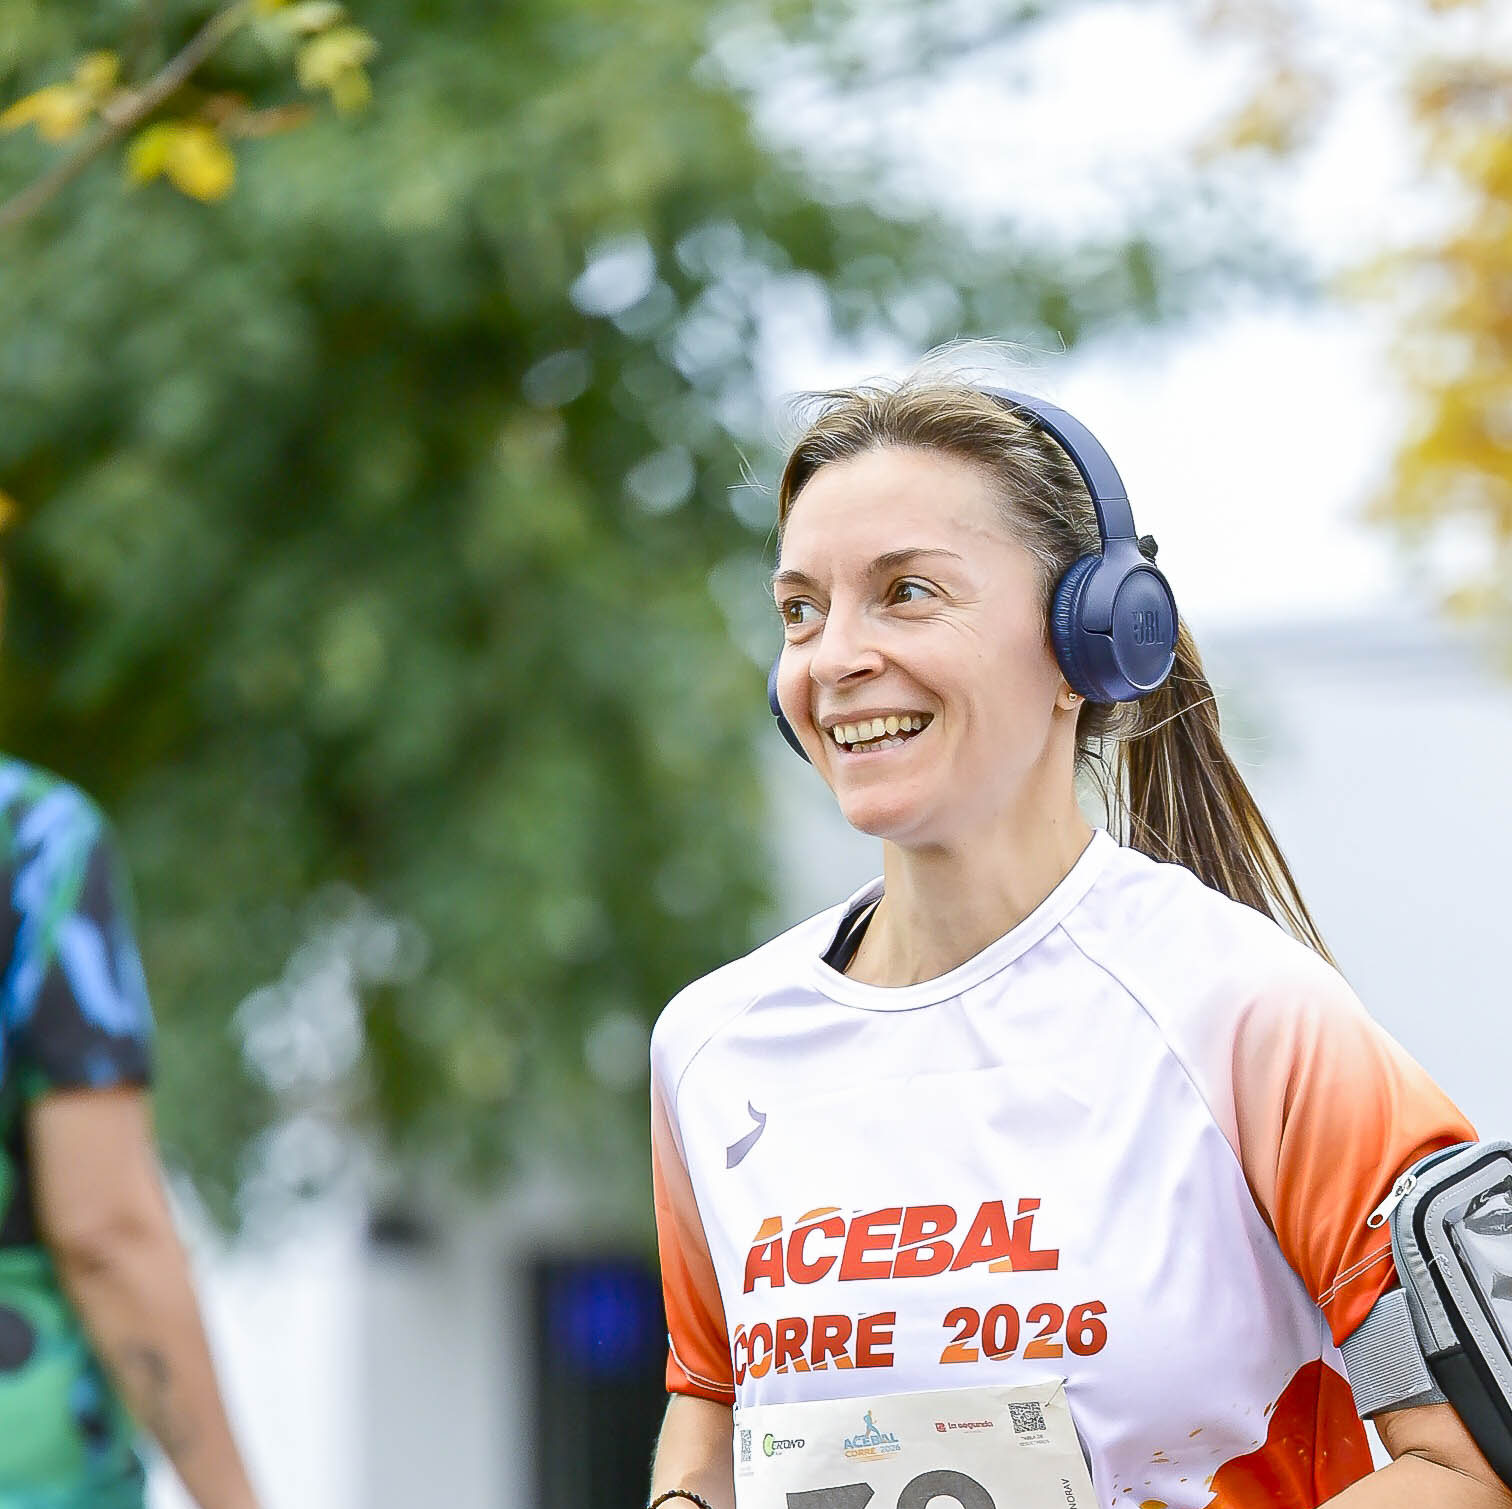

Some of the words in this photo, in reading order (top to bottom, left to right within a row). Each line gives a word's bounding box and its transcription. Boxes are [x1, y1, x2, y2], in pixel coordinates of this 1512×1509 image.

[1131, 610, 1164, 646] JBL
[743, 1197, 1060, 1295] ACEBAL
[734, 1310, 897, 1386] CORRE
[938, 1299, 1108, 1365] 2026
[958, 1420, 994, 1430] segunda
[844, 1432, 899, 1450] ACEBAL
[844, 1447, 876, 1458] CORRE
